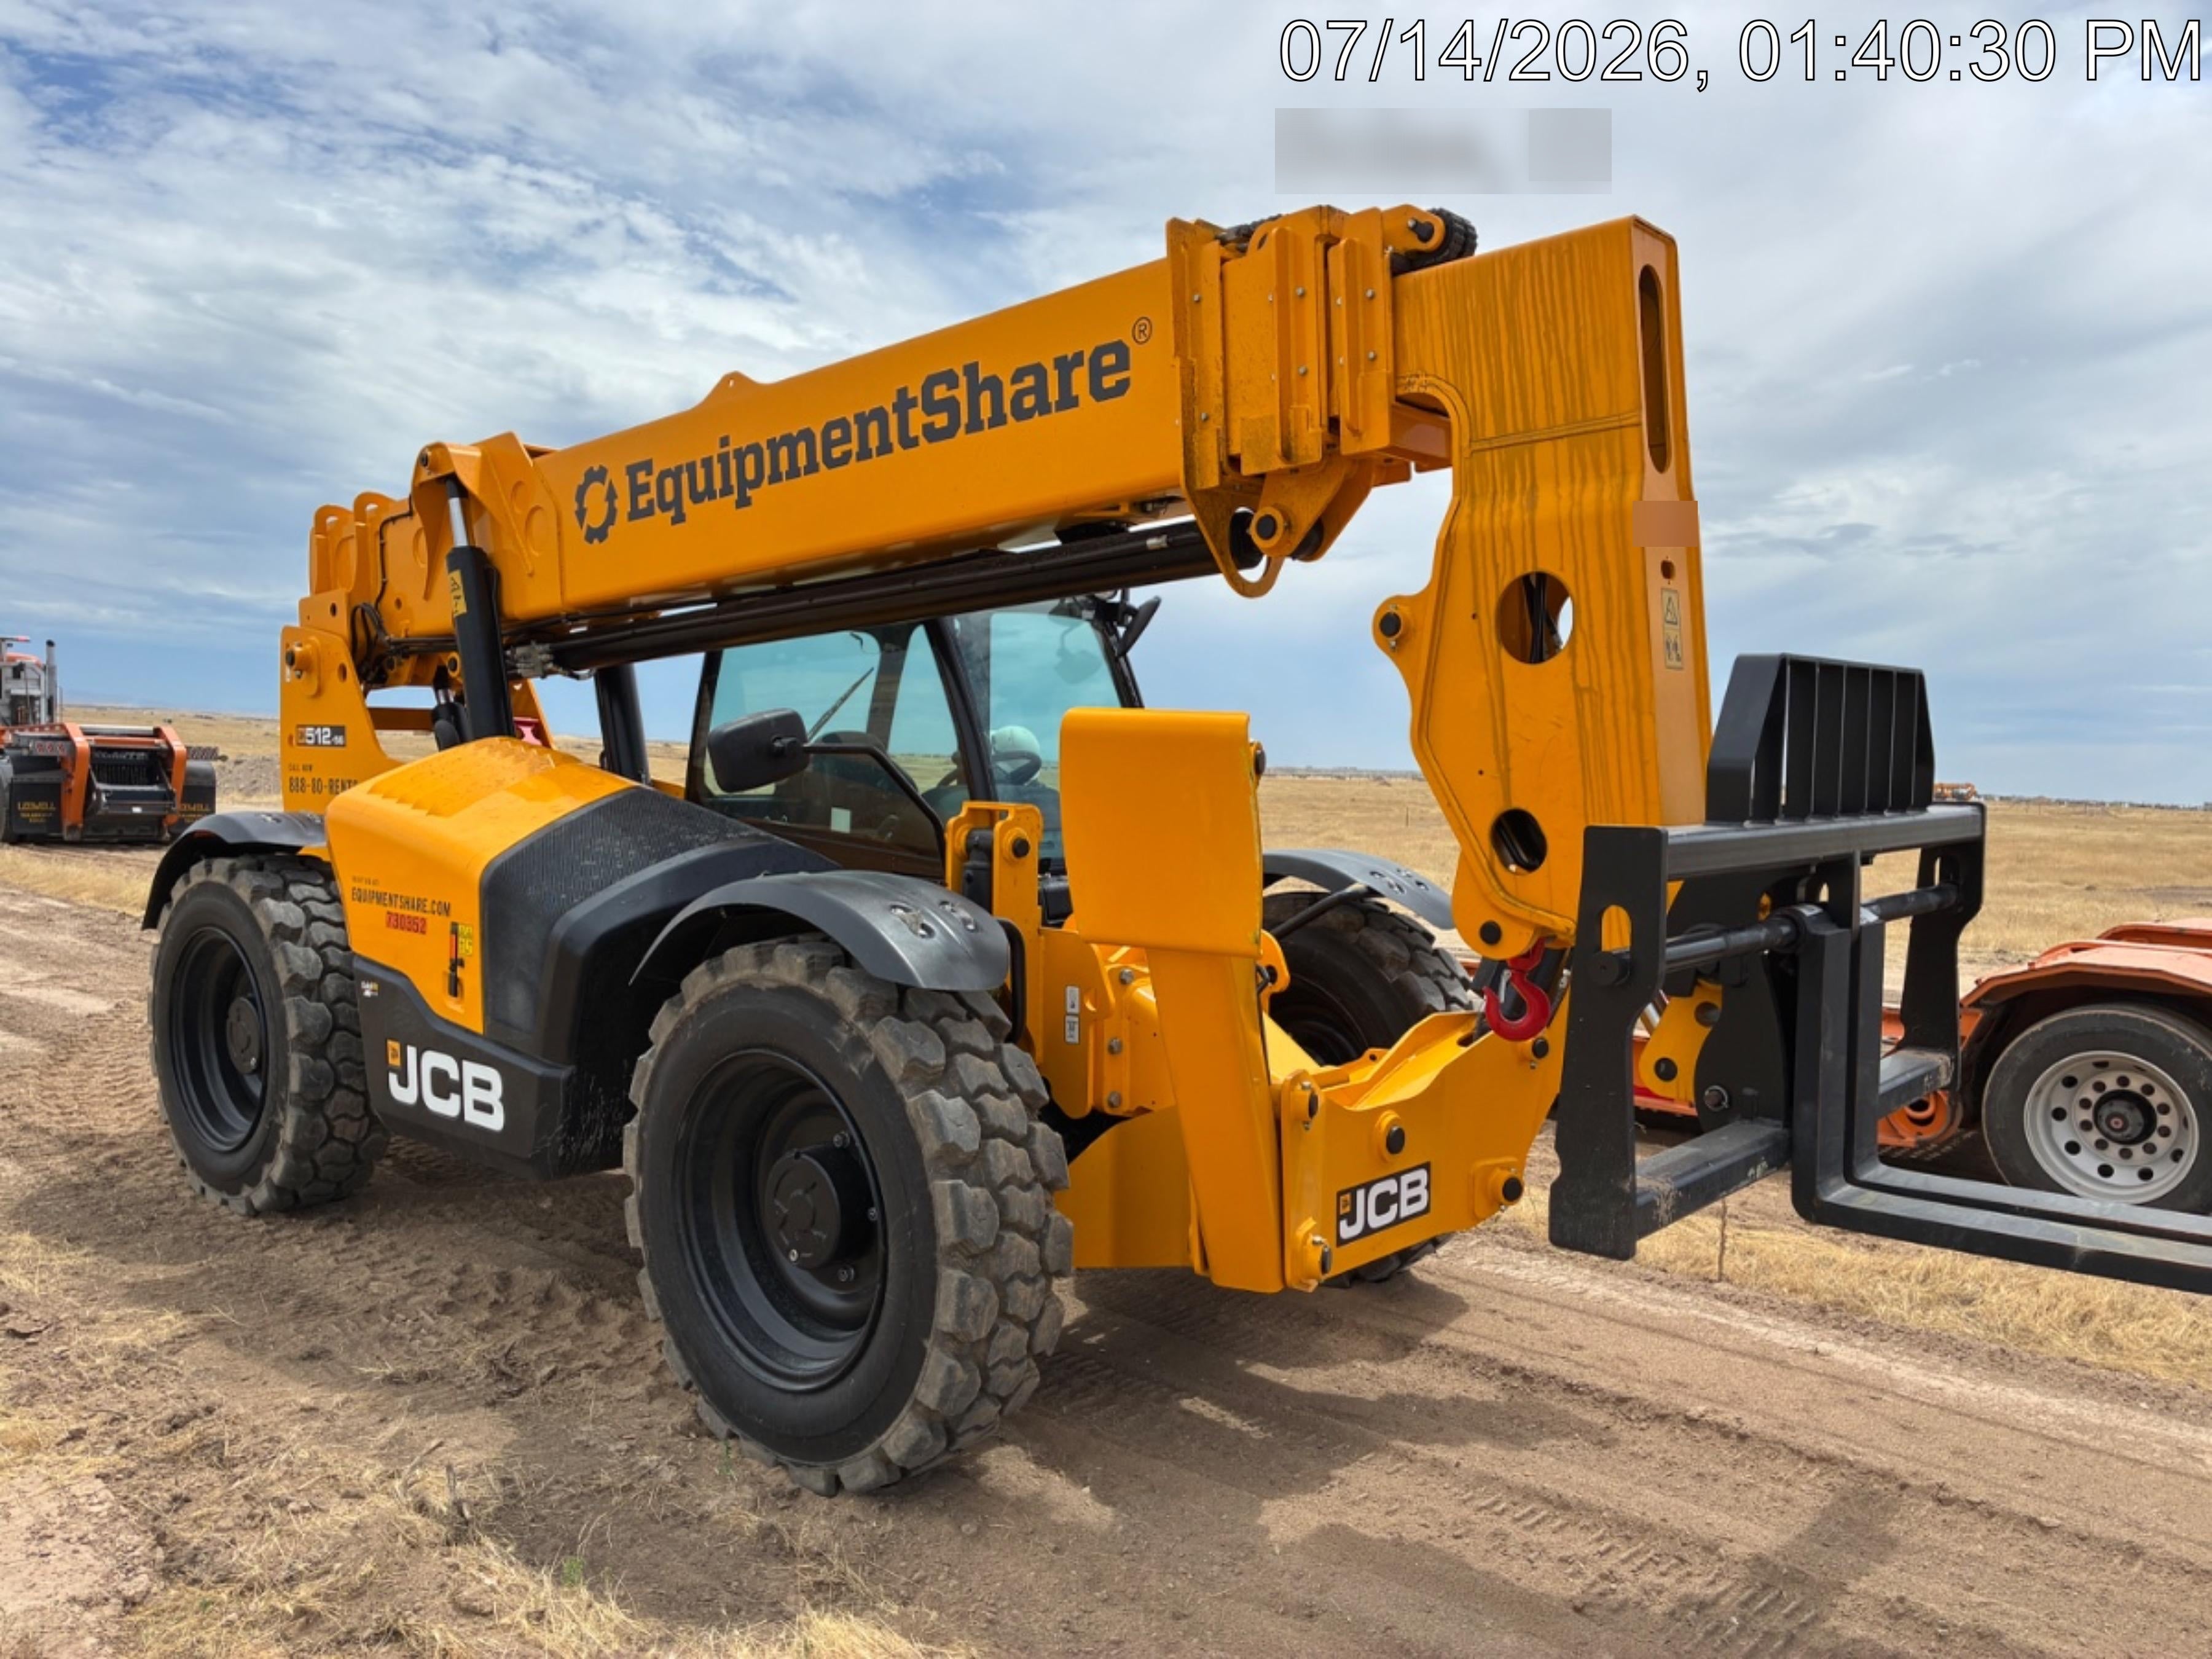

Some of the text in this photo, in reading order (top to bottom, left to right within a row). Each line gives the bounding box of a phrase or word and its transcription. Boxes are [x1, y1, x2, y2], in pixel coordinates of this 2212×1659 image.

[352, 887, 451, 917] EQUIPMENTSHARE.COM
[388, 1045, 504, 1132] JCB
[1339, 1167, 1429, 1240] JCB
